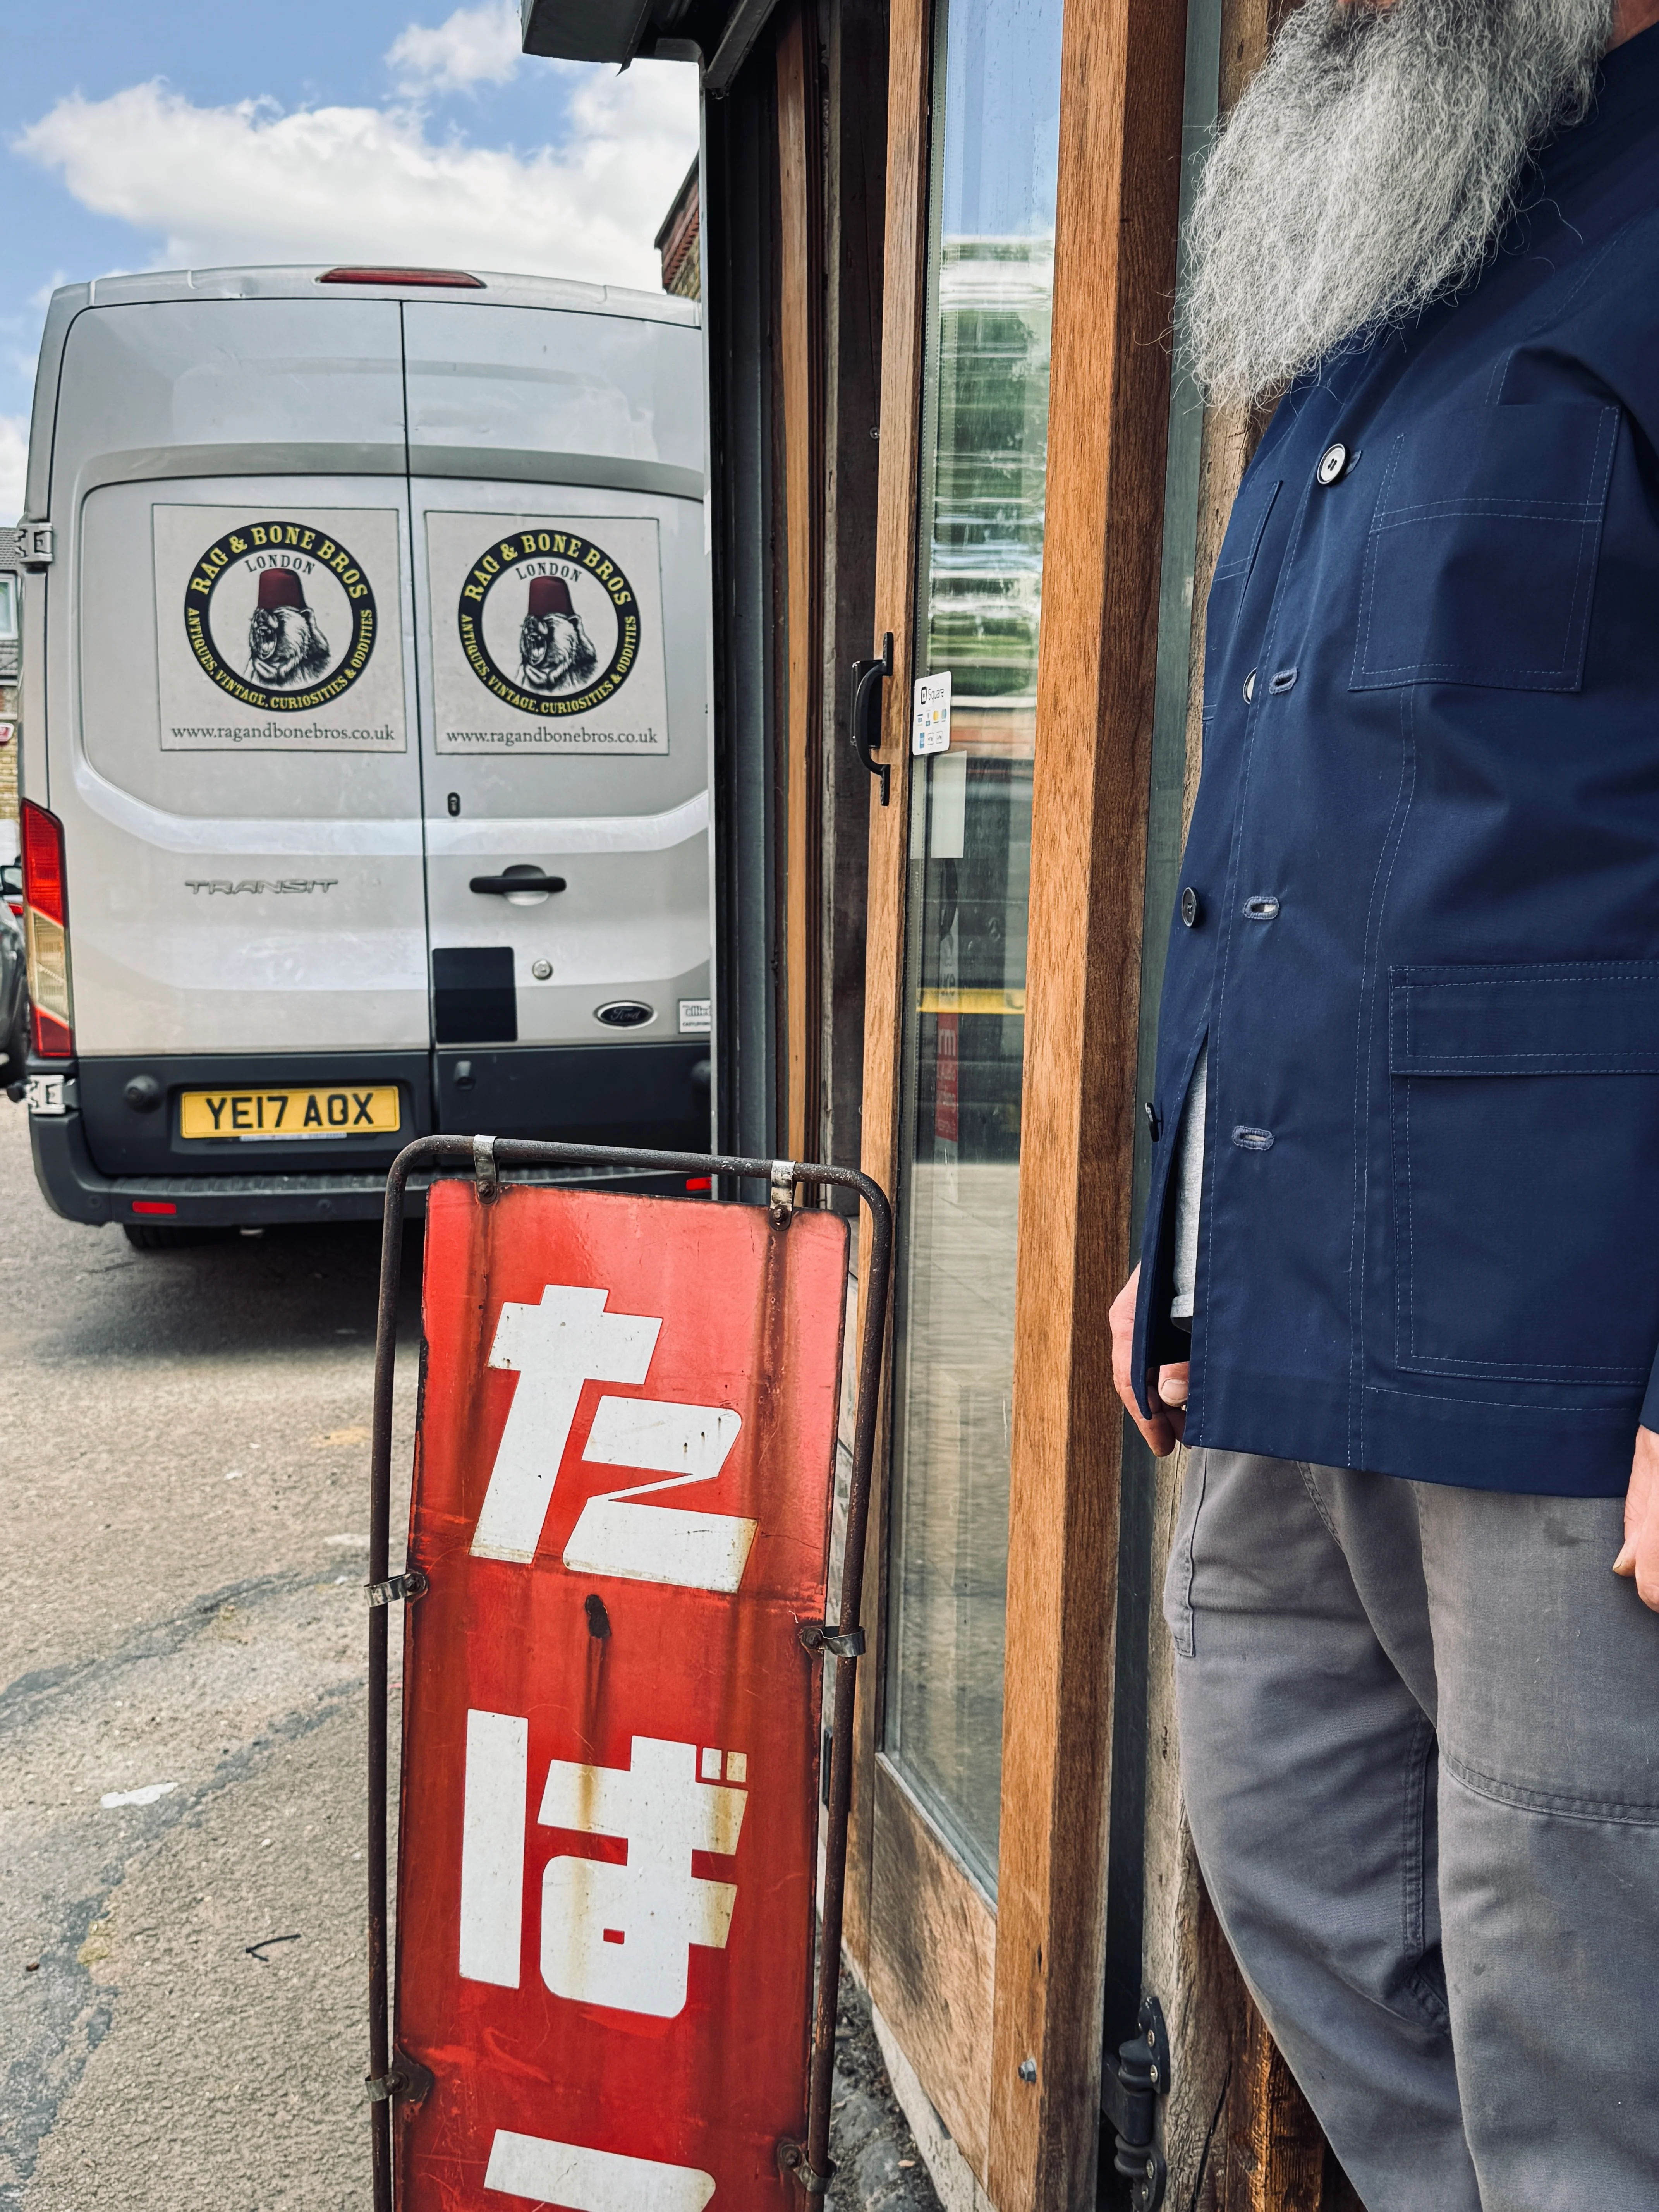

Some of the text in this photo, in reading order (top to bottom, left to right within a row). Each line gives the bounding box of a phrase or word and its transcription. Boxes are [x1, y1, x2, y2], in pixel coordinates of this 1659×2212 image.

[191, 525, 368, 598] RAG & BONE BROS
[244, 554, 316, 575] LONDON
[464, 532, 632, 605] RAG & BONE BROS
[515, 562, 582, 582] LONDON
[270, 675, 348, 709] CURIOSITIES
[343, 668, 357, 679] &
[350, 609, 373, 668] ODDITIES
[540, 680, 615, 714] CURIOSITIES
[610, 673, 622, 684] &
[616, 615, 637, 673] ODDITIES
[171, 722, 395, 742] www.ragandbonebros.co.uk
[446, 726, 658, 746] www.ragandbonebros.co.uk
[184, 879, 339, 895] TRANSIT
[610, 1007, 641, 1020] Ford
[205, 1092, 374, 1130] YE17 AOX
